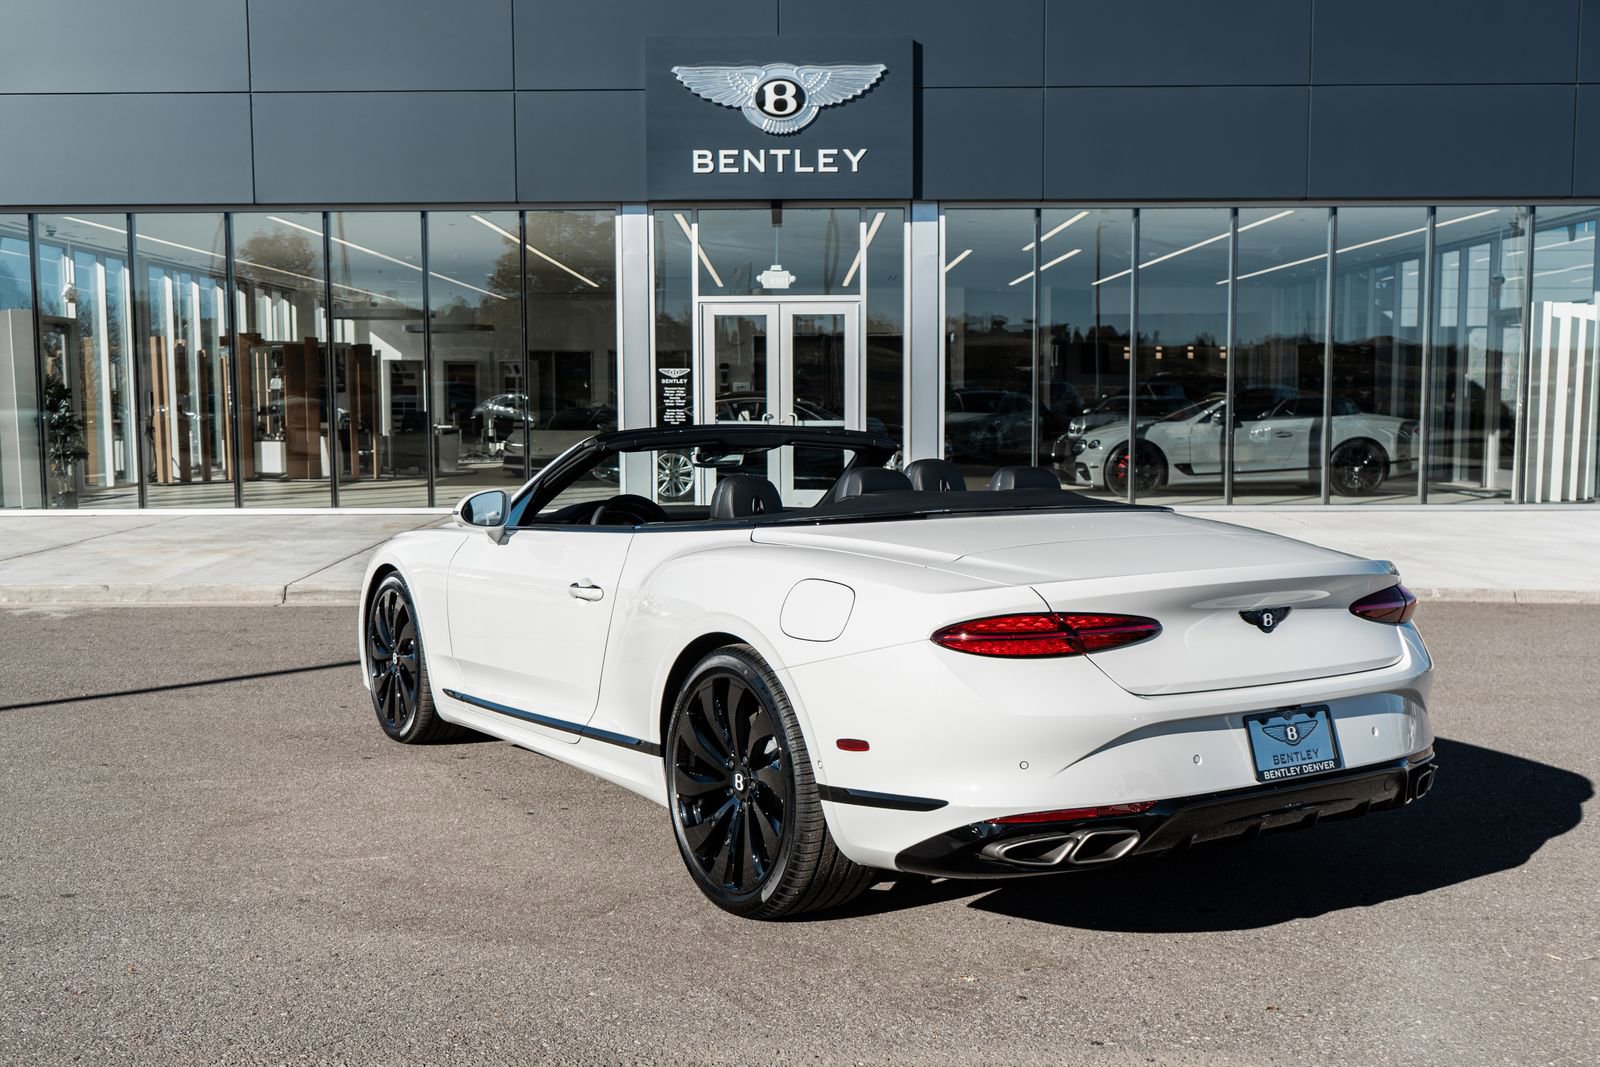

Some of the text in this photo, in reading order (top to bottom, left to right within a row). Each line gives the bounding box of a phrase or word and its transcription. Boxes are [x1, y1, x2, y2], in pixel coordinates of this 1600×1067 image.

[762, 80, 798, 116] B
[692, 148, 868, 174] BENTLEY
[1263, 612, 1273, 627] B
[1272, 748, 1319, 766] BENTLEY
[1264, 760, 1335, 780] BENTLEY DENVER
